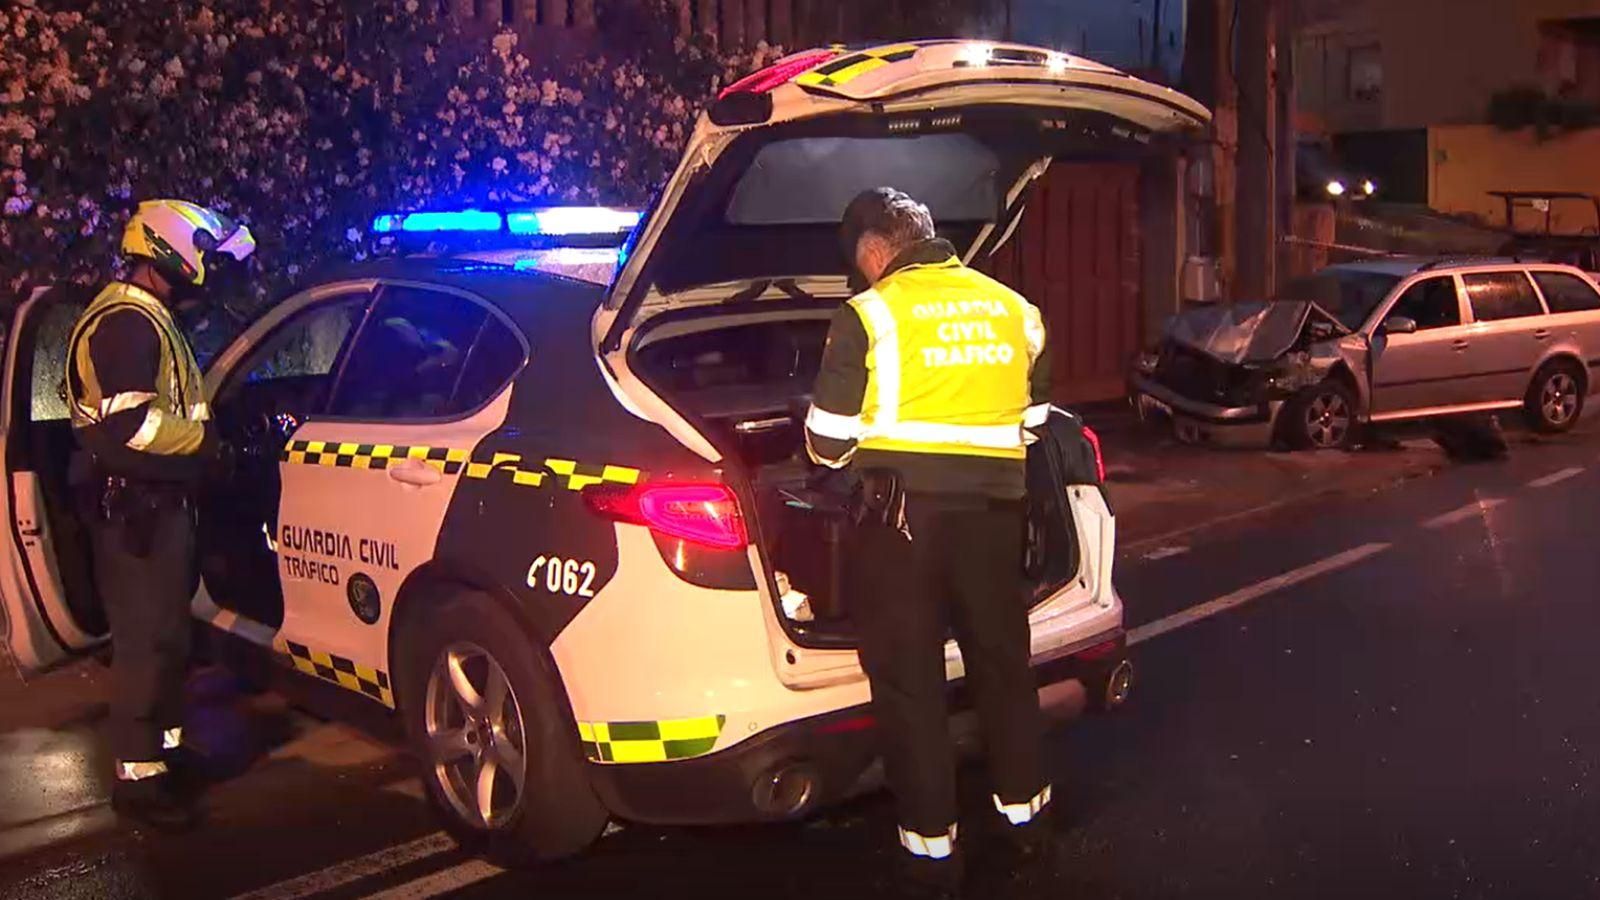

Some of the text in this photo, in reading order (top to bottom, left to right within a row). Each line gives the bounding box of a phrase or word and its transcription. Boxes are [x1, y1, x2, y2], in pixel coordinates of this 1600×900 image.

[911, 300, 1009, 319] GUARDIA
[937, 321, 997, 342] CIVIL
[922, 343, 1014, 367] TRAFICO
[282, 525, 399, 570] GUARDIA CIVIL
[546, 556, 596, 597] 062
